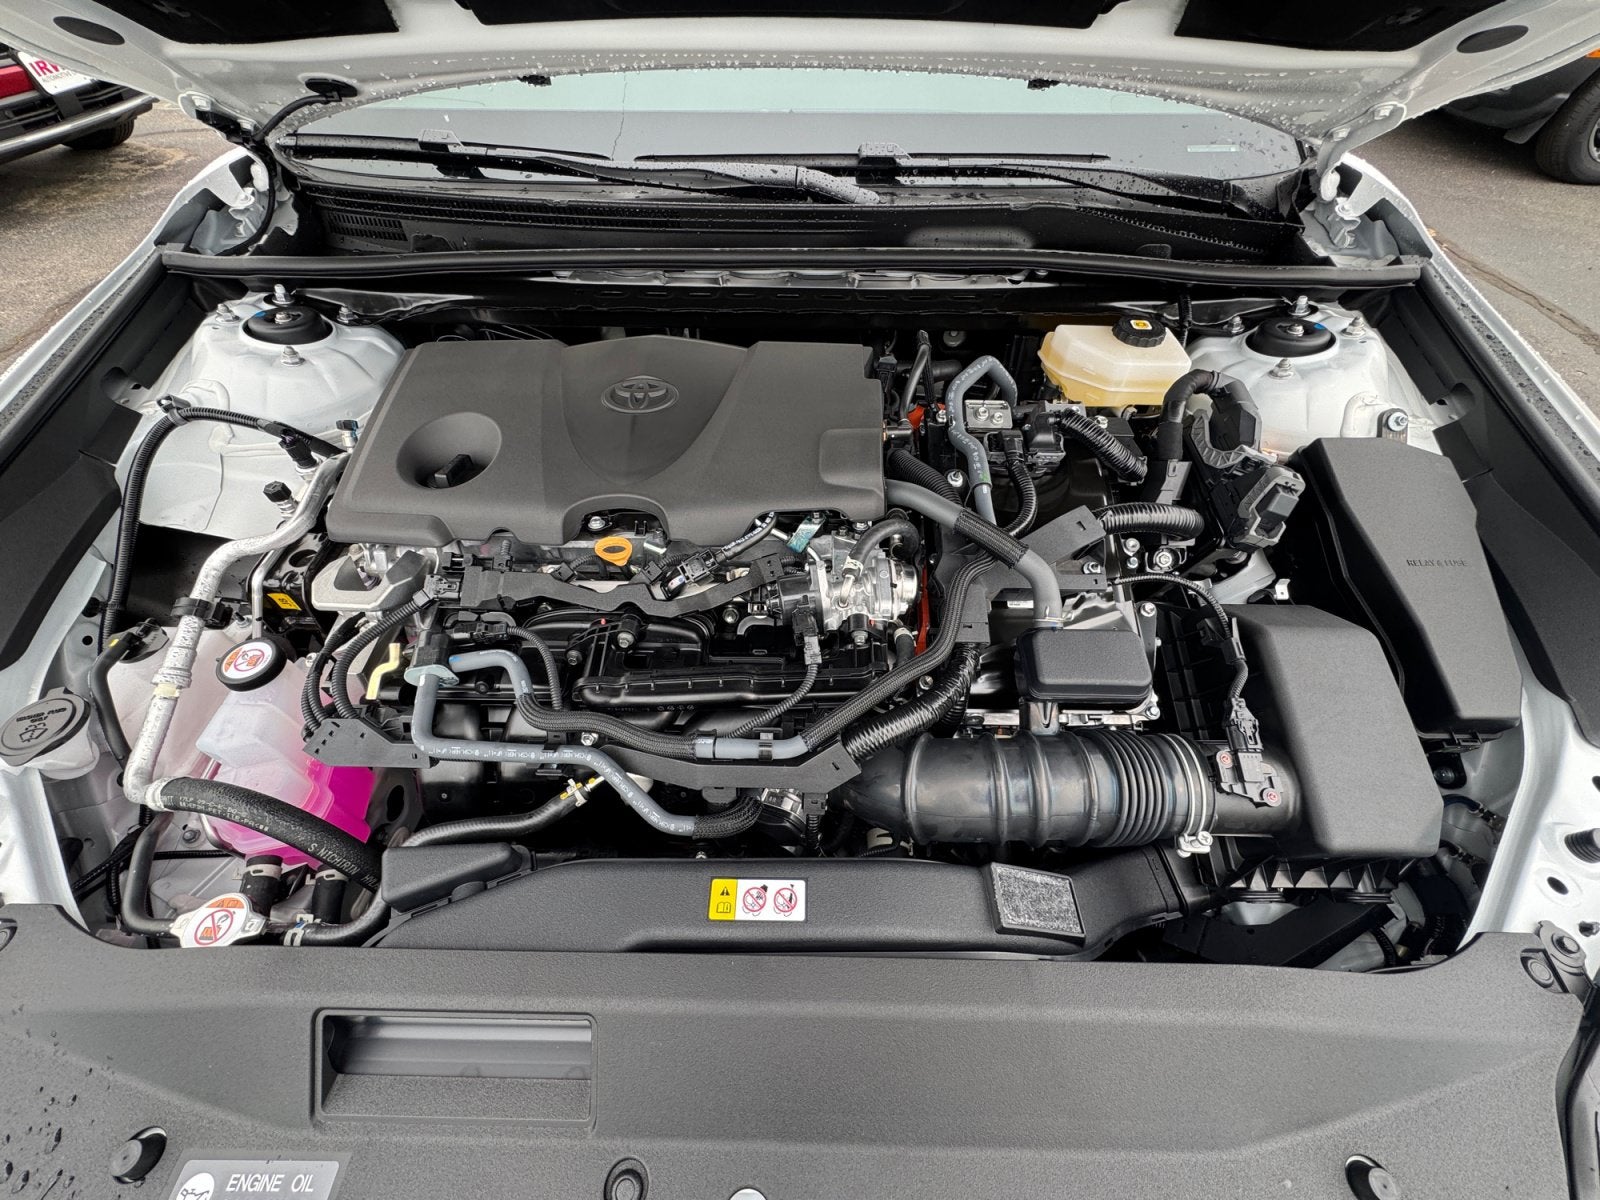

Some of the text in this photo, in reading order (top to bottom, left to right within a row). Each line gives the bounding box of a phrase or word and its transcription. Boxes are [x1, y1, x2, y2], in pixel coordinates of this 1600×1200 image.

[1406, 559, 1435, 567] RELAY
[226, 1173, 314, 1193] ENGINE OIL
